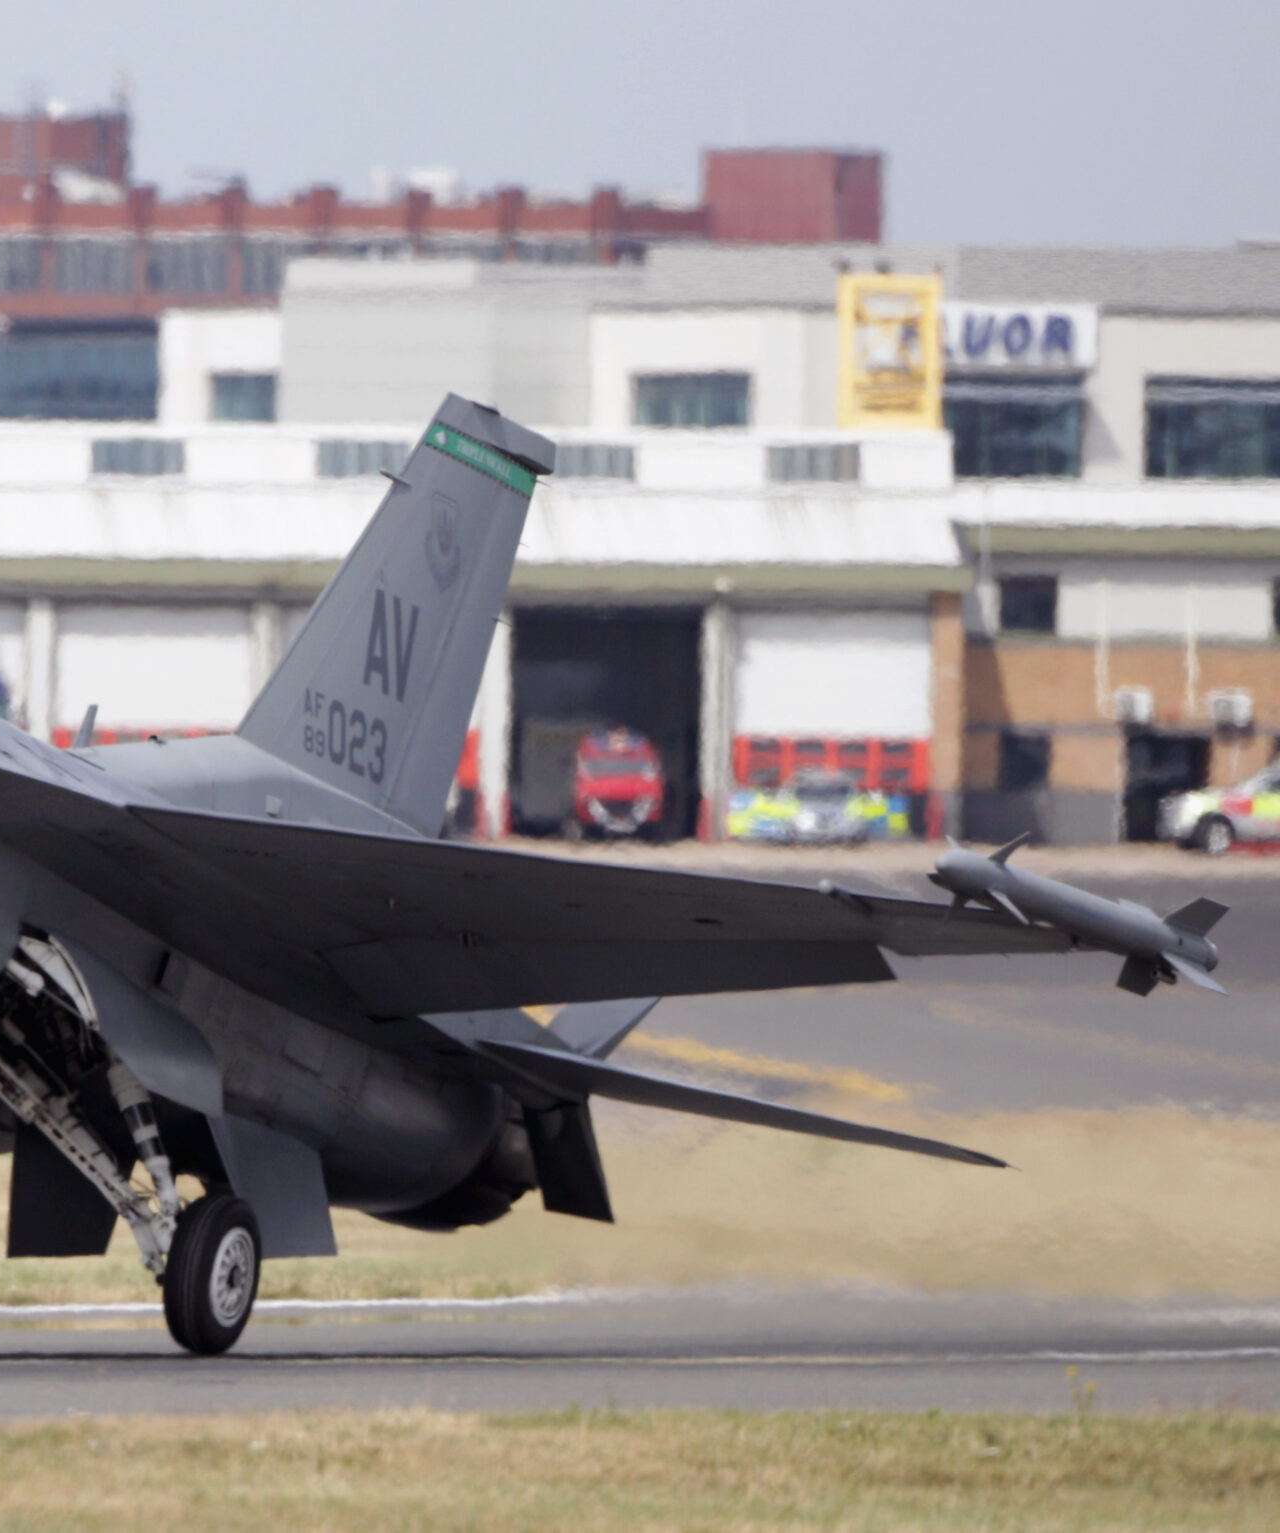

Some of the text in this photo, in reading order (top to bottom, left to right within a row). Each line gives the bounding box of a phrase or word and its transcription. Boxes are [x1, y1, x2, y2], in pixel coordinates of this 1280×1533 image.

[900, 313, 1073, 358] UOR
[362, 588, 420, 703] AV
[304, 687, 326, 719] AF
[304, 699, 387, 784] 89 023
